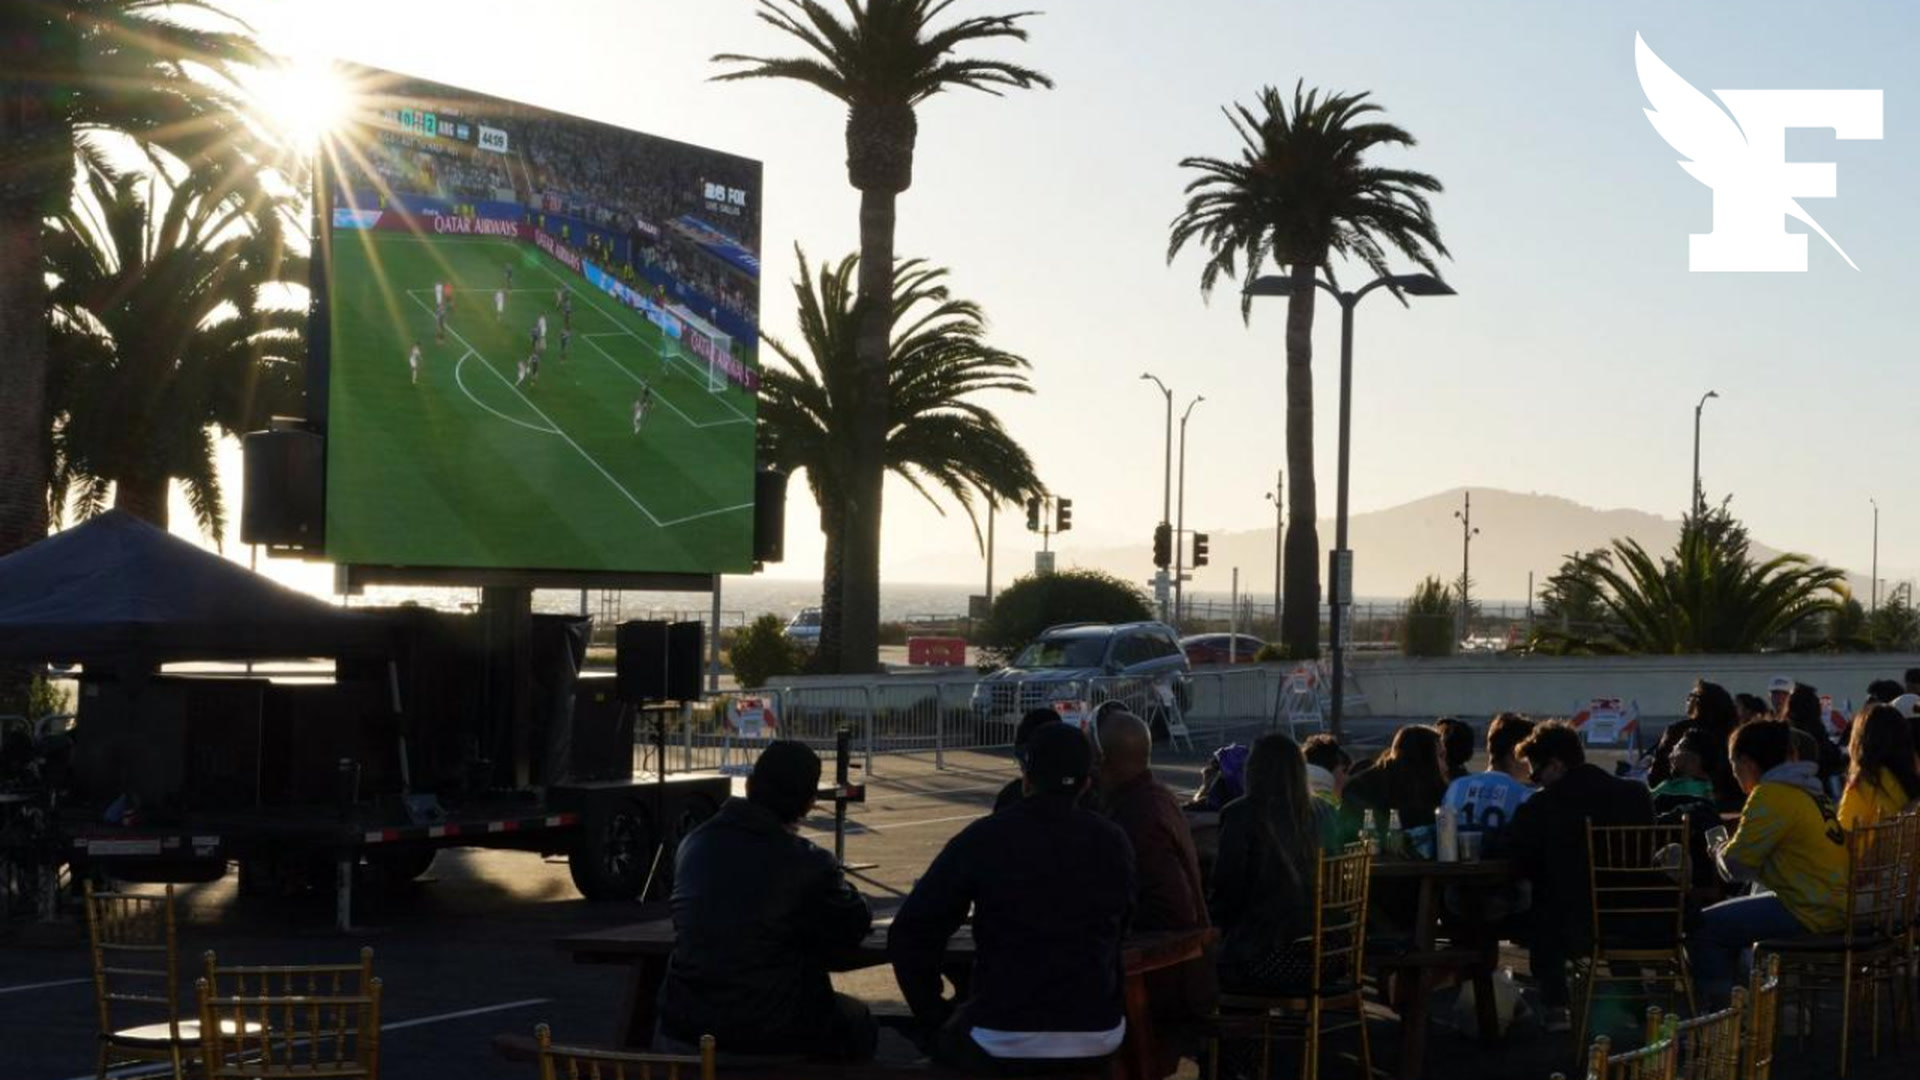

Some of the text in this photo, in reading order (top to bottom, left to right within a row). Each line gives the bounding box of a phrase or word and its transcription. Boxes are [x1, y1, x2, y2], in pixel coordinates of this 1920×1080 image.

[727, 187, 746, 207] FOX
[434, 215, 518, 236] QATAR AIRWAYS
[1462, 801, 1507, 832] 10
